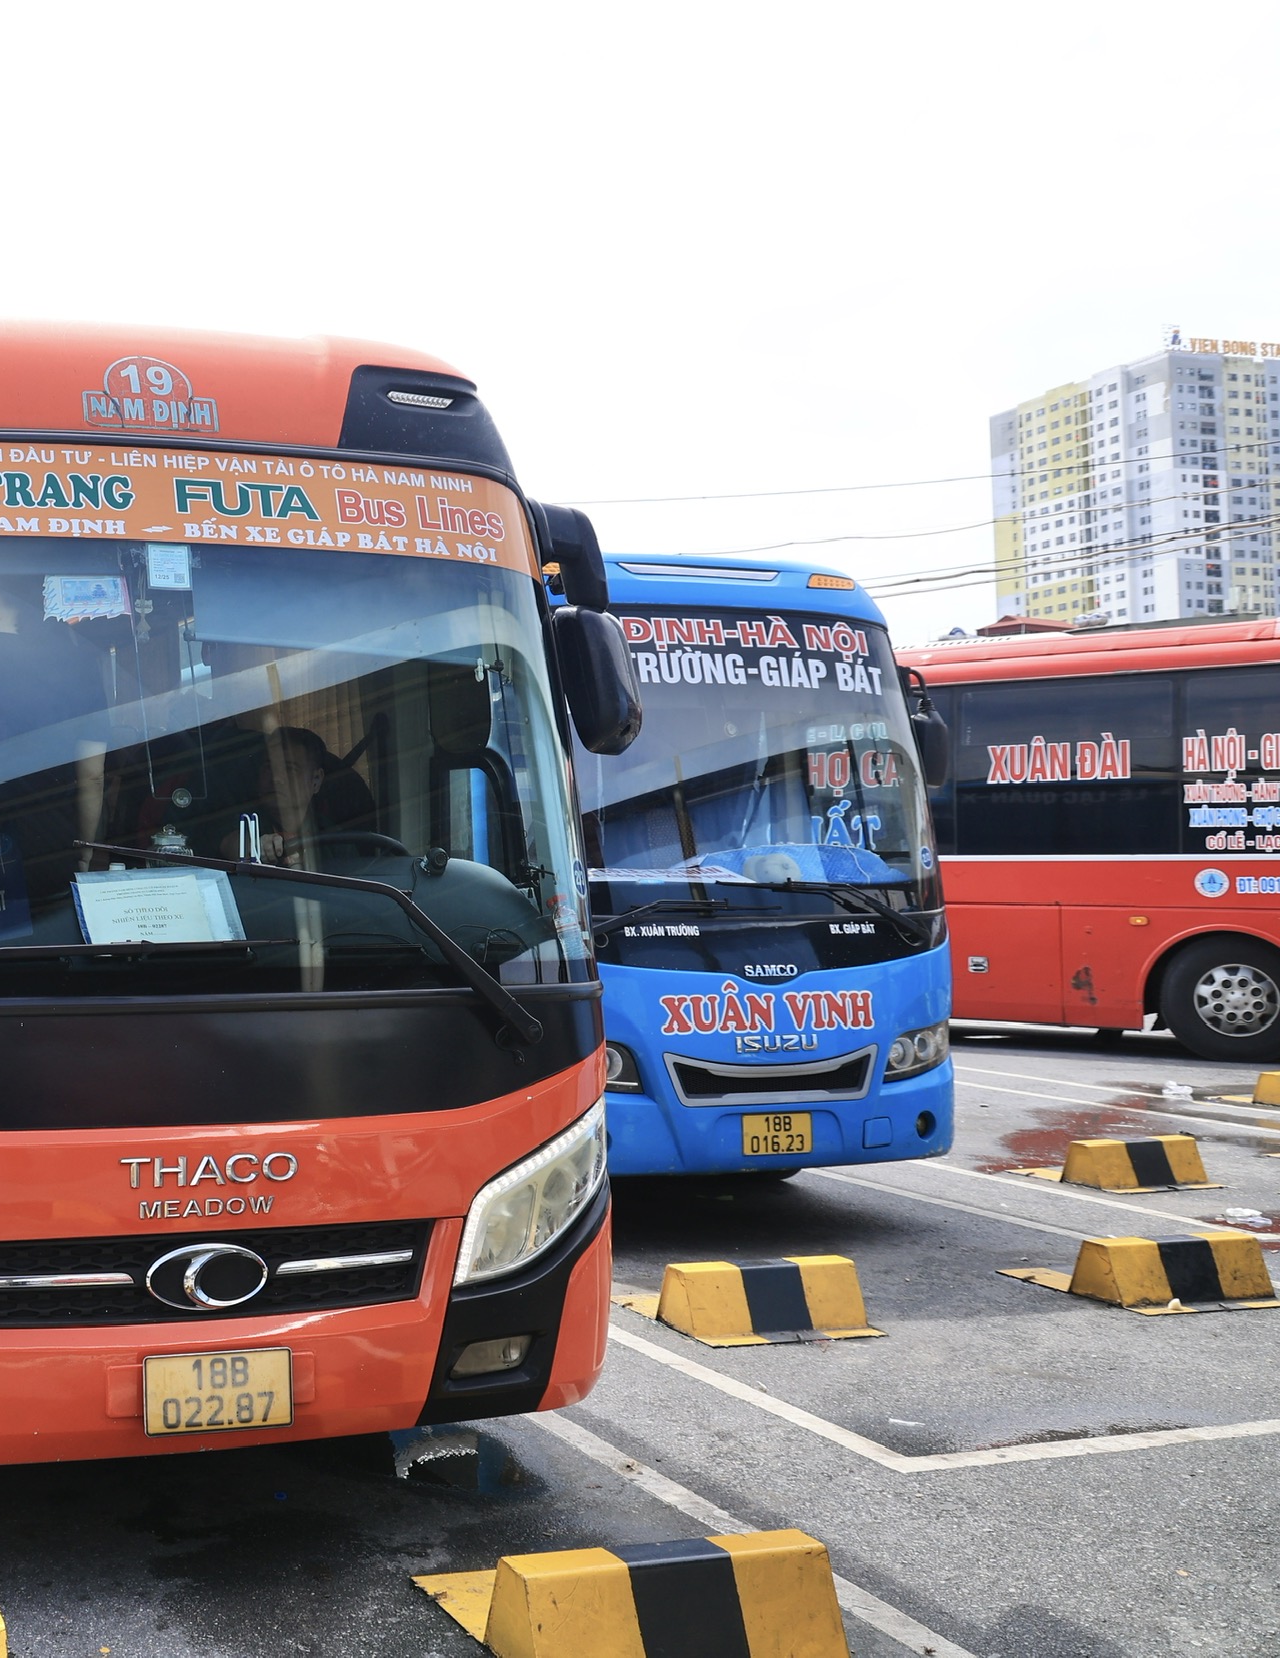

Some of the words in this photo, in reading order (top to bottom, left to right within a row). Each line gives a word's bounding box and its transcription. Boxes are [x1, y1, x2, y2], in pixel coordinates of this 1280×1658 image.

[120, 364, 173, 396] 19
[91, 396, 145, 421] NAM
[152, 399, 212, 429] ĐỊNH
[8, 445, 54, 464] ĐẦU
[61, 450, 92, 465] TƯ
[111, 449, 157, 468] LIÊN
[163, 453, 210, 473] HIỆP
[215, 456, 257, 476] VẬN
[262, 458, 295, 477] TẢI
[300, 459, 315, 478] Ô
[320, 460, 347, 480] TÔ
[351, 464, 380, 484] HÀ
[384, 471, 425, 488] NAM
[430, 475, 473, 494] NINH
[173, 477, 321, 522] FUTA
[335, 488, 407, 528] Bus
[417, 495, 505, 542] Lines
[48, 517, 126, 537] ĐỊNH
[184, 518, 238, 540] BẾN
[245, 526, 281, 543] XE
[288, 526, 350, 548] GIÁP
[358, 531, 409, 552] BÁT
[415, 535, 451, 556] HÀ
[457, 540, 497, 566] NỘI
[619, 615, 800, 651] ĐỊNH-HÀ
[803, 621, 870, 662] NỘI
[631, 646, 827, 690] RƯỜNG-GIÁP
[835, 651, 883, 696] BÁT
[986, 735, 1071, 785] XUÂN
[1075, 732, 1131, 780] ĐÀI
[1183, 729, 1210, 772] HÀ
[1211, 728, 1246, 779] NỘI
[807, 749, 850, 797] HỢ
[1236, 876, 1259, 894] ĐT:
[624, 927, 640, 937] BX.
[640, 923, 665, 937] XUÂN
[665, 923, 700, 937] TRƯỜNG
[744, 964, 798, 977] SAMCO
[660, 980, 775, 1035] XUÂN
[784, 990, 874, 1031] VINH
[736, 1034, 819, 1054] ISUZU
[764, 1115, 792, 1133] 18B
[751, 1134, 805, 1154] 016.23
[119, 1152, 298, 1189] THACO
[139, 1196, 275, 1219] MEADOW
[192, 1356, 250, 1391] 18B
[162, 1391, 275, 1430] 022.87
